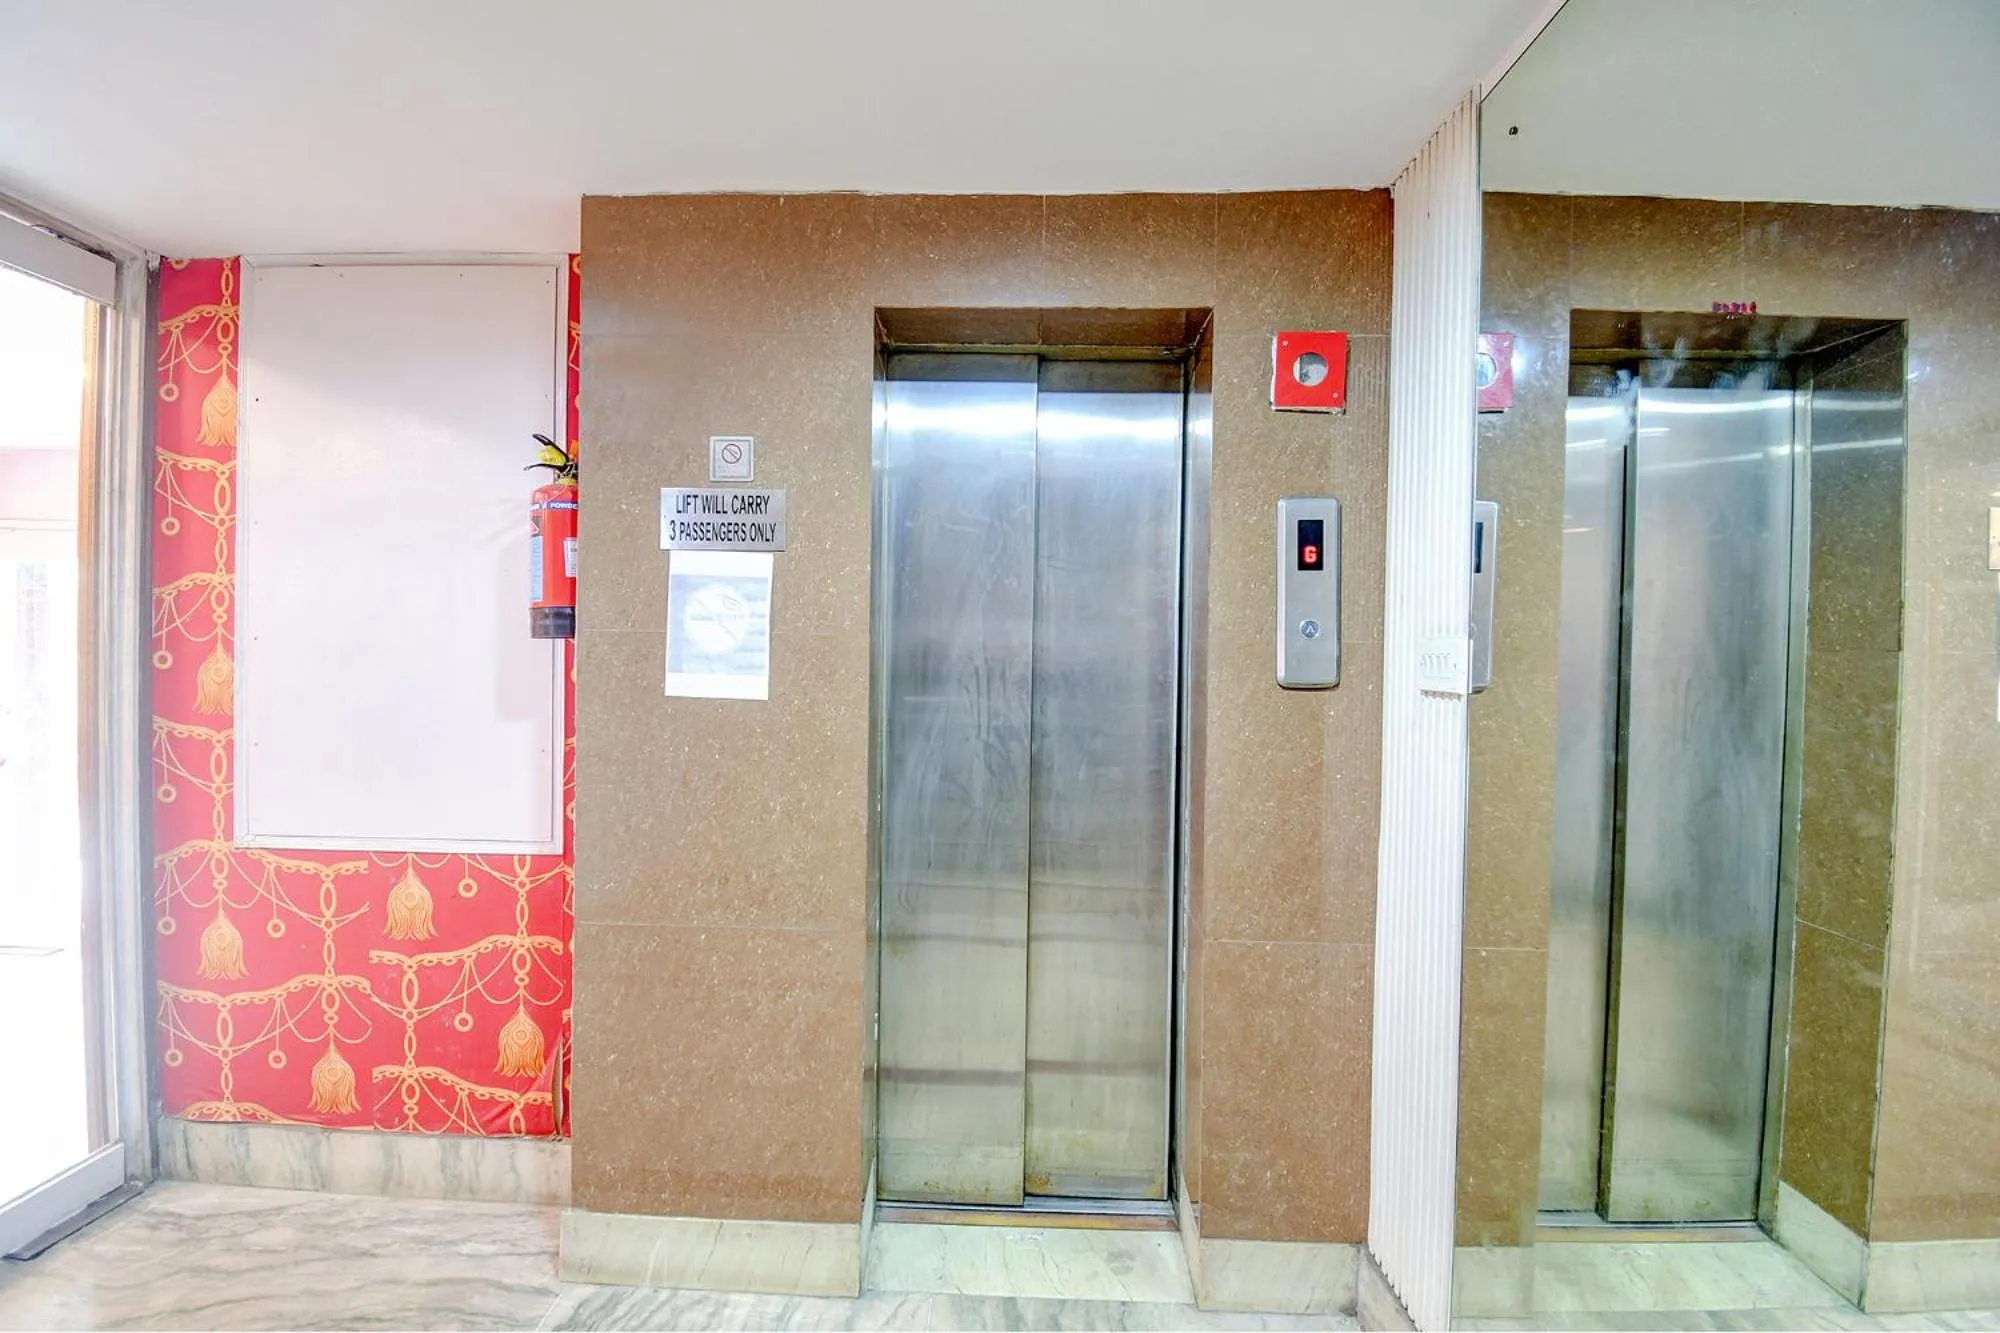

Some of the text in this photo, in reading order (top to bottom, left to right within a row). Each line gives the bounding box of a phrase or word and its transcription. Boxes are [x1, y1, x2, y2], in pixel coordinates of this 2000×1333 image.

[676, 495, 770, 515] LIFT WILL CARRY
[669, 520, 777, 542] 3 PASSENGERS ONLY
